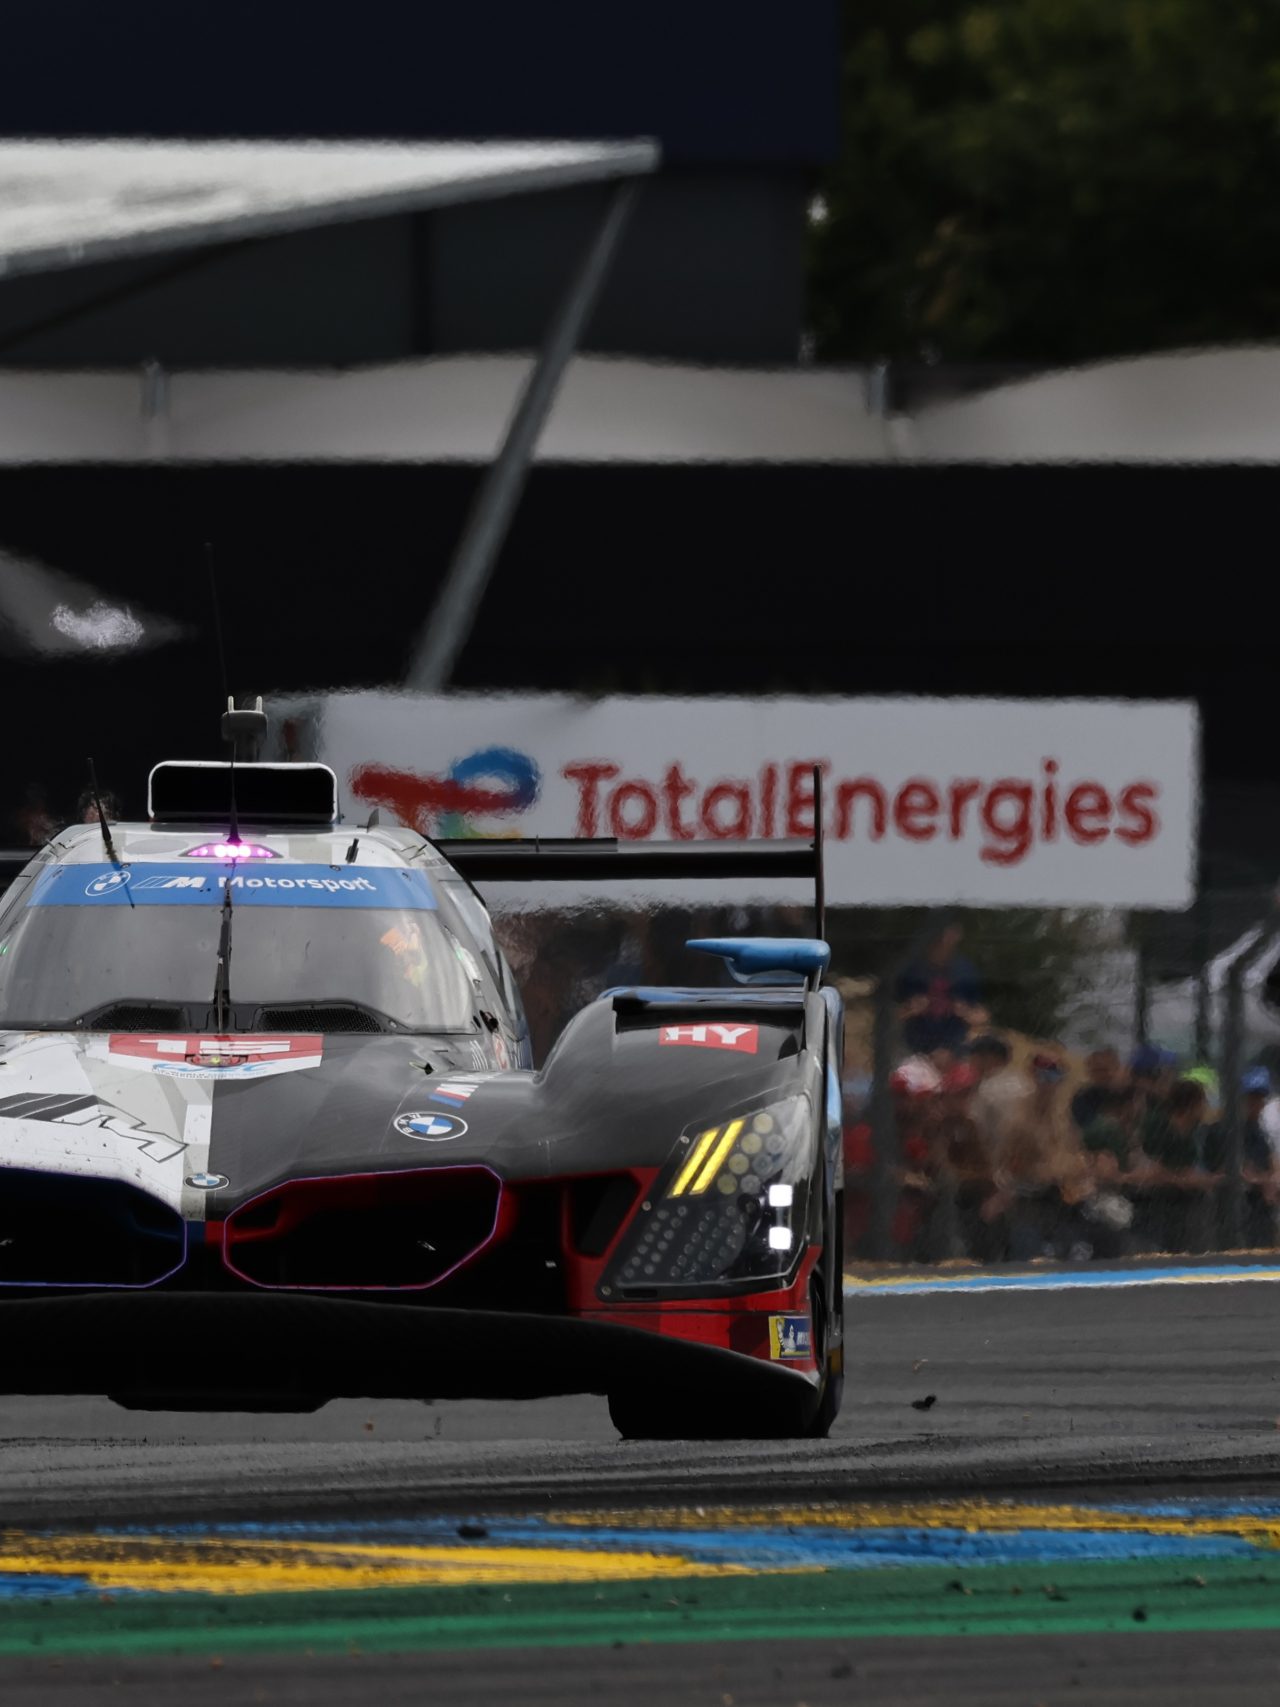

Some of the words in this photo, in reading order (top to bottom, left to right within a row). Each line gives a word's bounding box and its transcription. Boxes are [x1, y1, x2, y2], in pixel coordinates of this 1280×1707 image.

[559, 757, 1162, 868] TotalEnergies
[218, 875, 376, 892] Motorsport
[665, 1024, 753, 1045] HY
